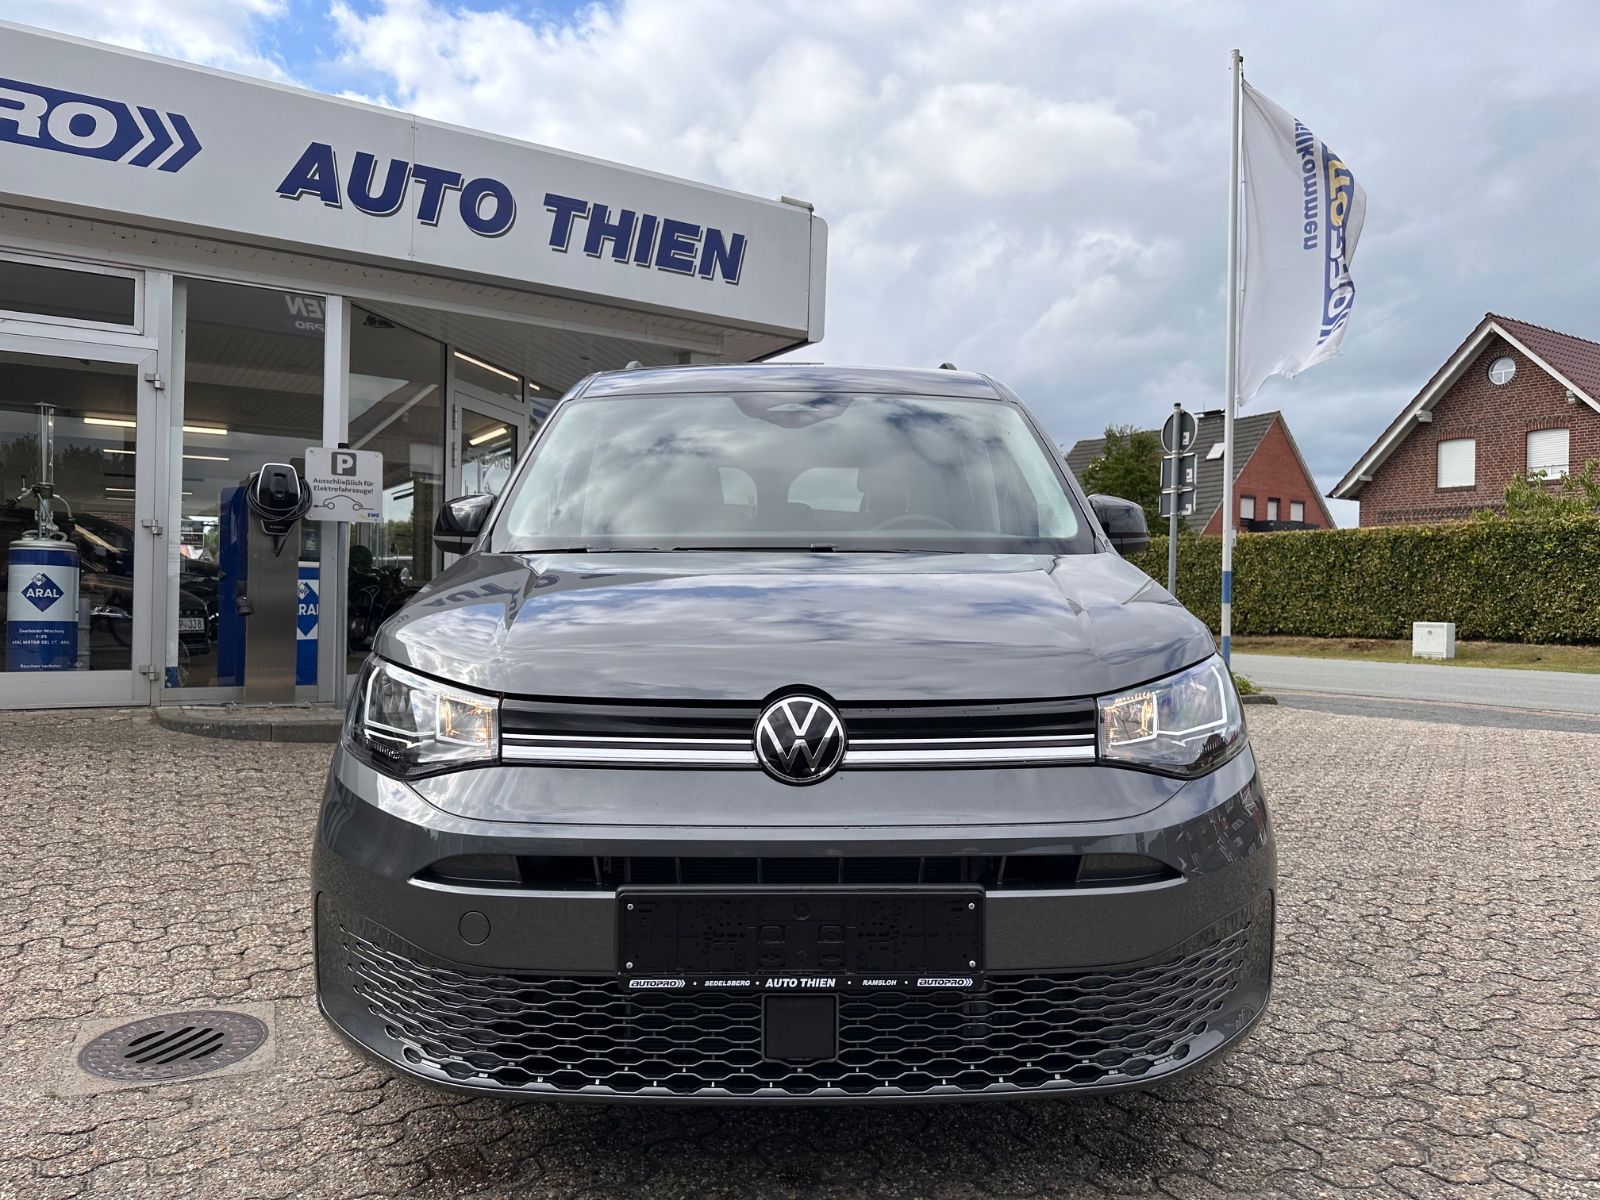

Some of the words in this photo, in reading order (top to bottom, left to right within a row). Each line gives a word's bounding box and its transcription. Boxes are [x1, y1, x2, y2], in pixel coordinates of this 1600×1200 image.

[275, 141, 517, 238] AUTO
[543, 192, 747, 285] THIEN
[336, 454, 354, 474] P
[313, 478, 363, 487] Ausschließlich
[26, 588, 60, 598] ARAL
[297, 603, 319, 616] RA
[765, 978, 798, 988] AUTO
[800, 978, 836, 988] THIEN
